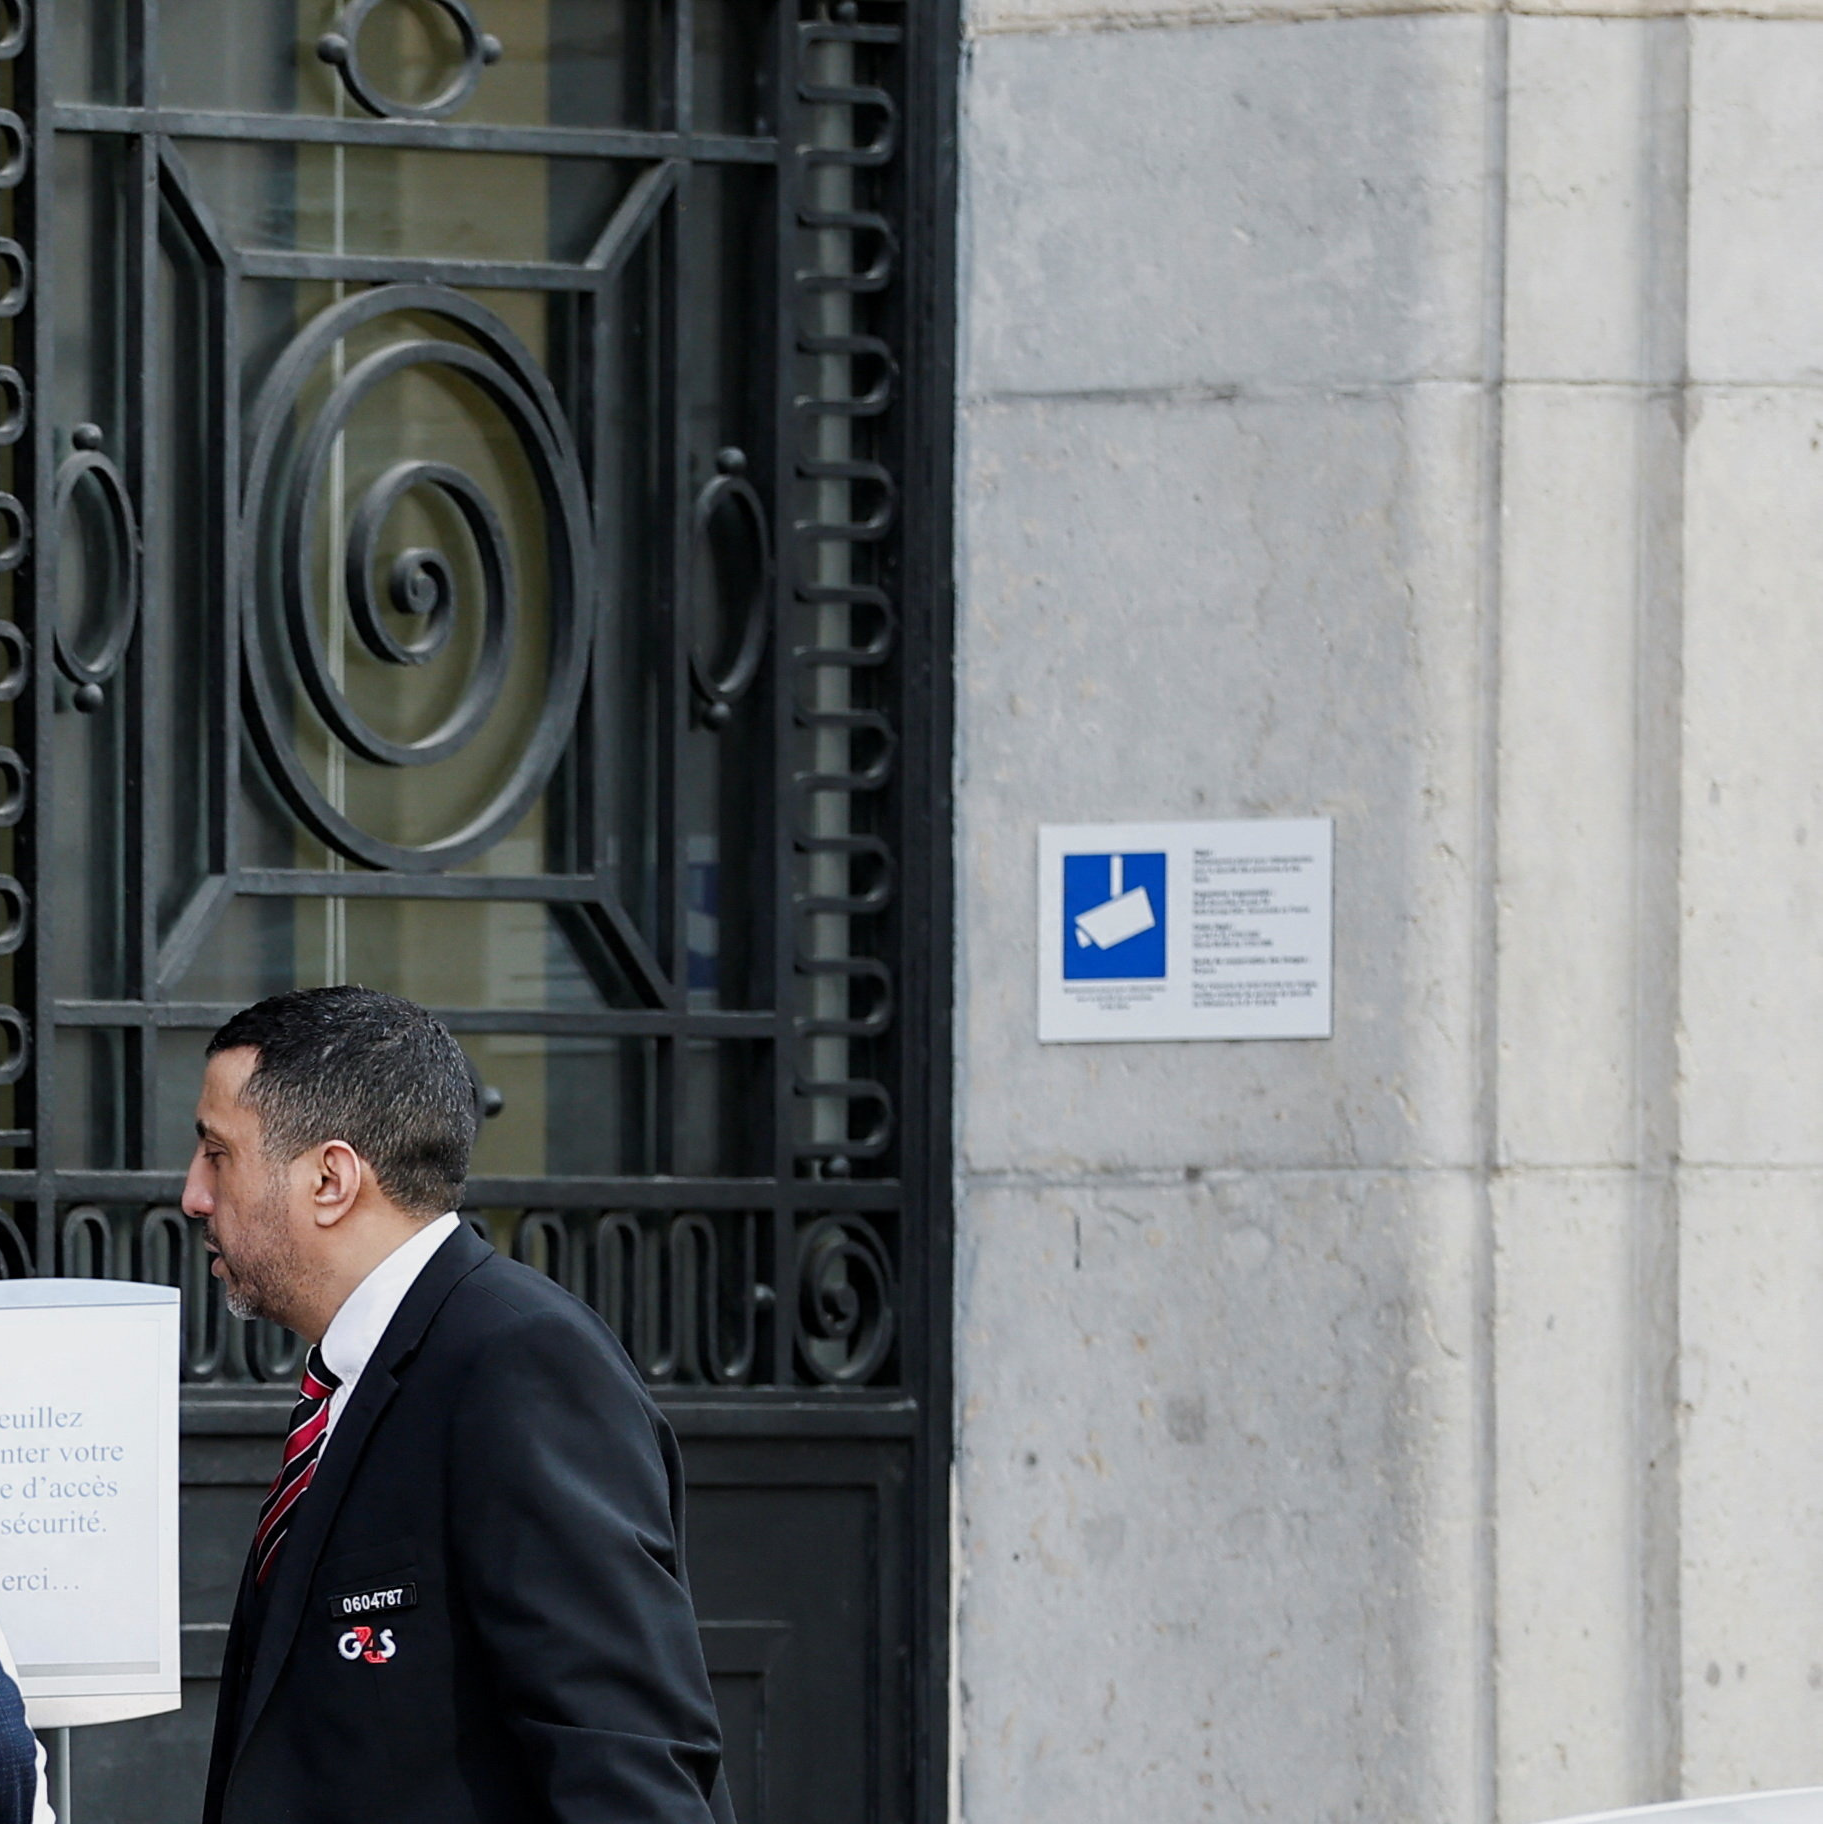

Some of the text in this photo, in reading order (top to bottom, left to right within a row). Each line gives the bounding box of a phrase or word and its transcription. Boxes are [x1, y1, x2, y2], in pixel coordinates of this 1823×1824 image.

[59, 1444, 124, 1462] votre
[0, 1510, 107, 1535] sécurité.
[342, 1588, 404, 1613] 0604787
